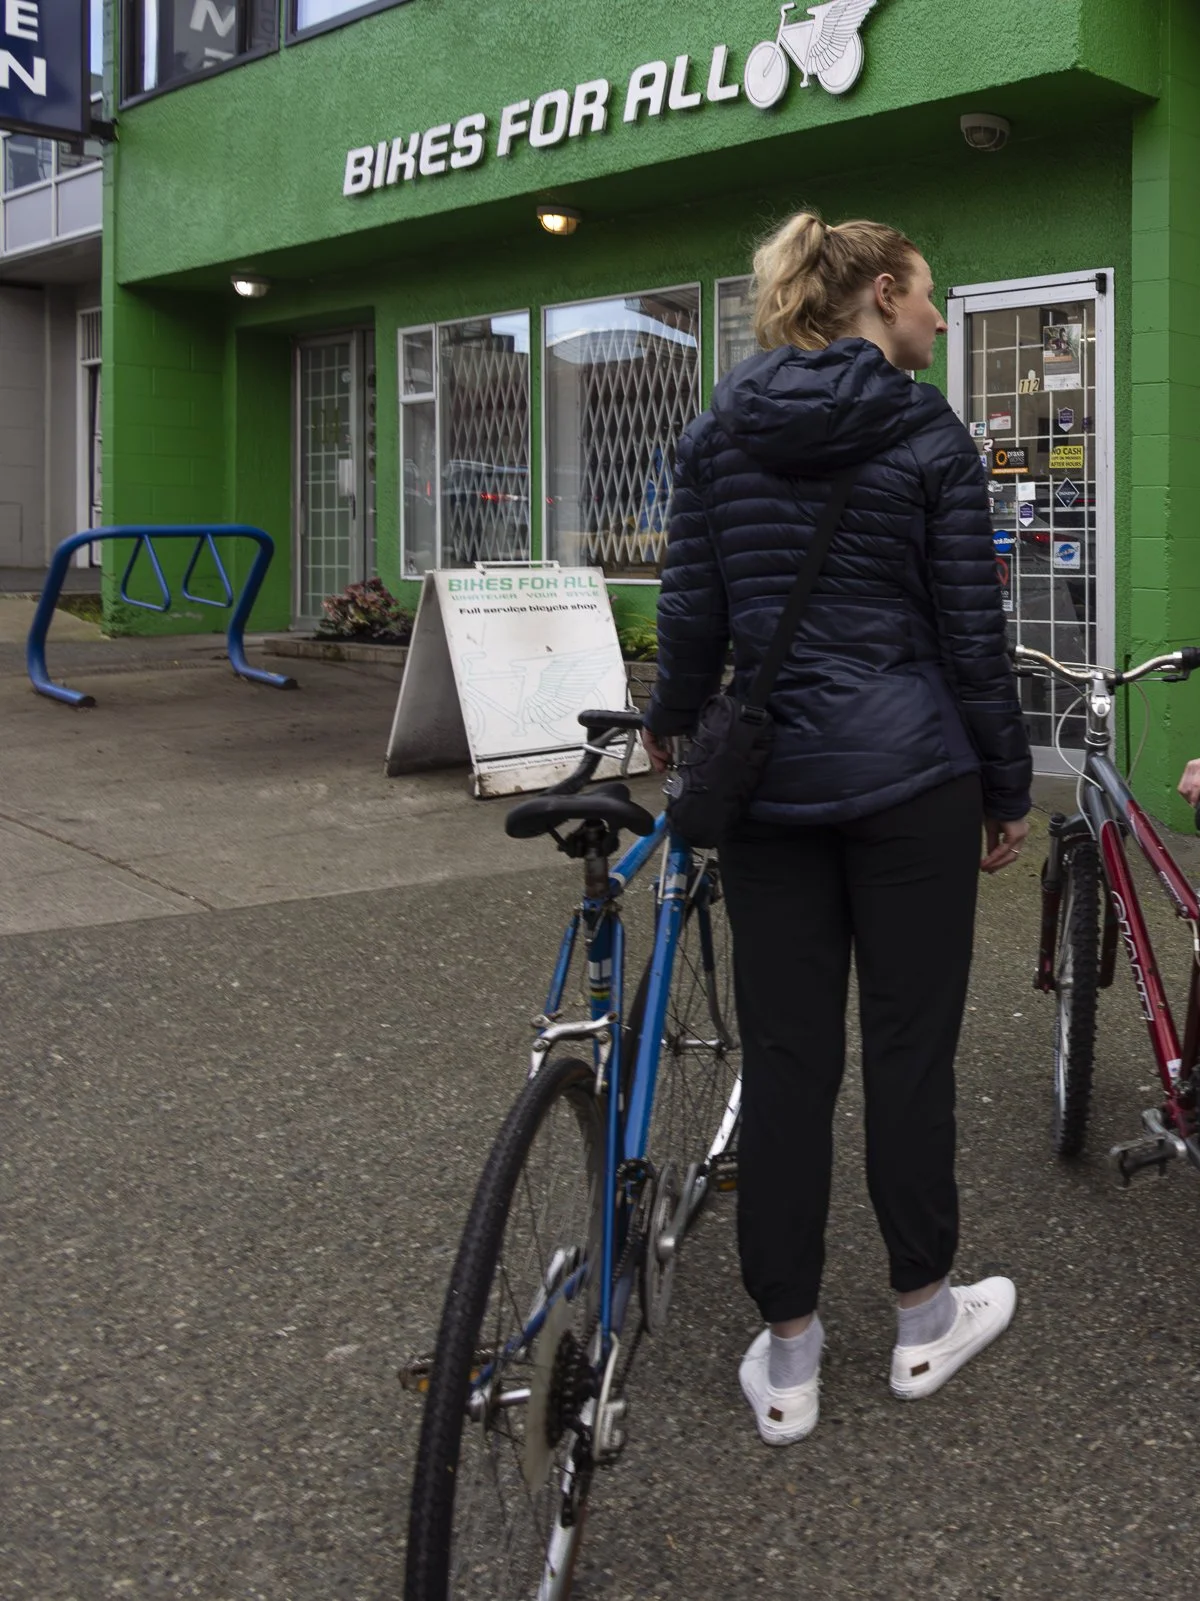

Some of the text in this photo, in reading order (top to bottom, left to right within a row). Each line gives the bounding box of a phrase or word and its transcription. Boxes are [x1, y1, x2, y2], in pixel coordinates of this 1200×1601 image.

[343, 44, 740, 196] BIKES FOR ALL
[1020, 379, 1038, 393] 112
[448, 575, 599, 592] BIKES FOR ALL
[451, 590, 600, 601] WHATEVER YOUR STYLE
[459, 602, 598, 615] Full service bicycle shop
